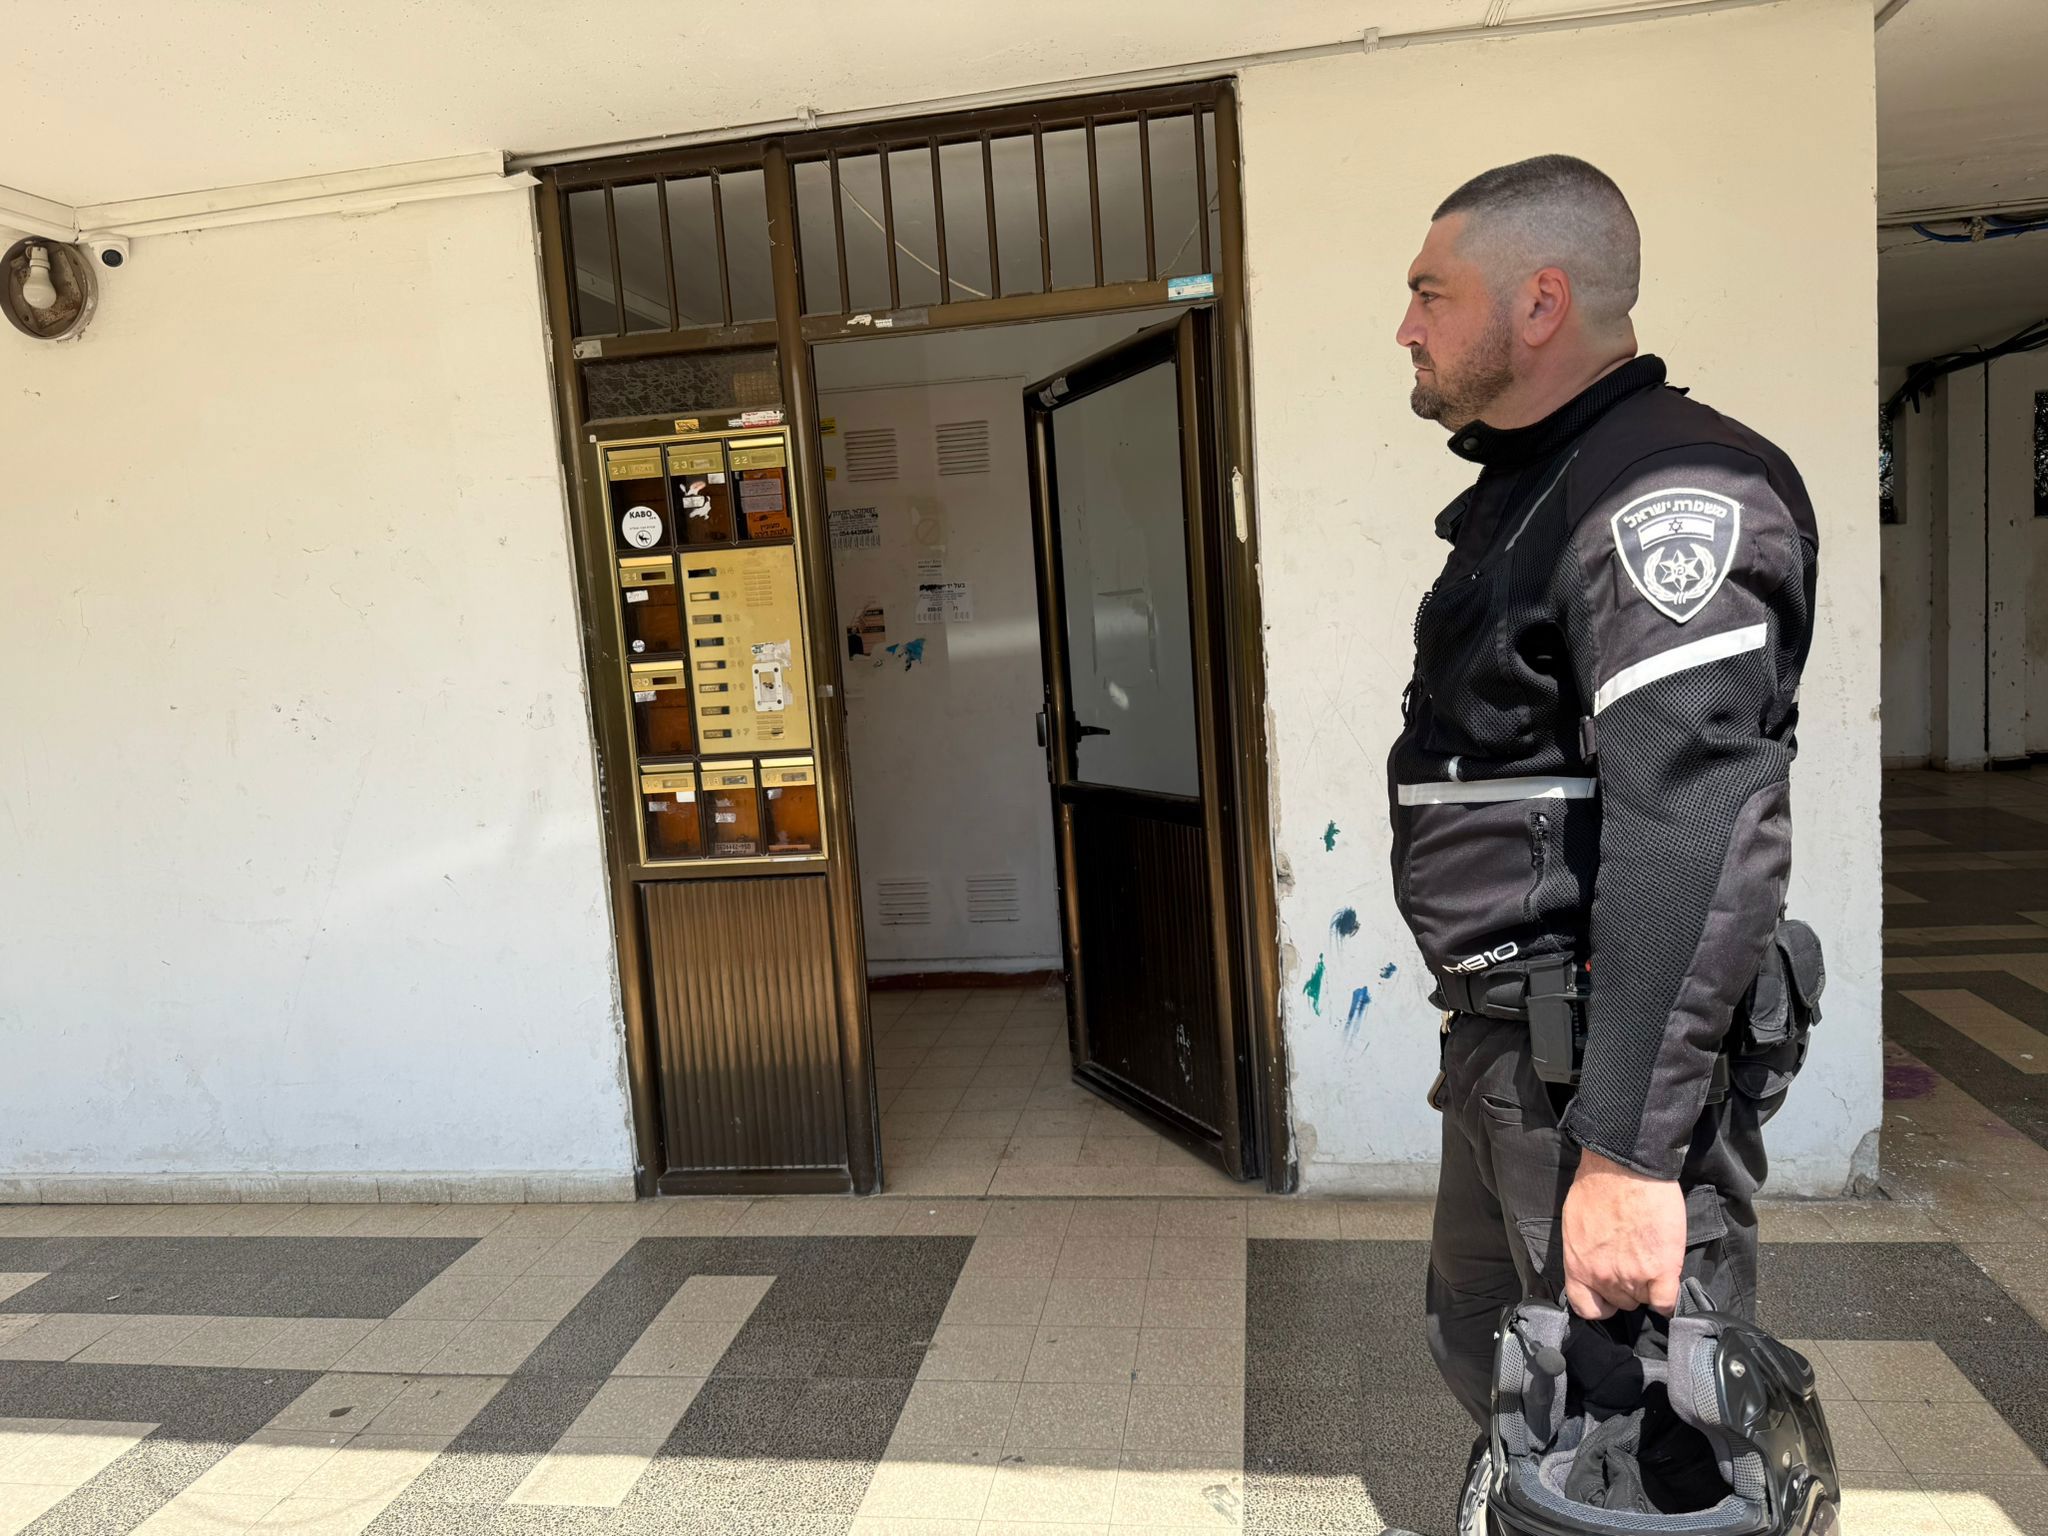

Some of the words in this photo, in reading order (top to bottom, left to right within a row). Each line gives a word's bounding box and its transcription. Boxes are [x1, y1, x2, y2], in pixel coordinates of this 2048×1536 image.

[734, 456, 748, 465] 22
[673, 461, 688, 470] 23
[1672, 500, 1728, 518] משטרת
[629, 510, 652, 519] KABO
[1623, 501, 1671, 529] ישראל
